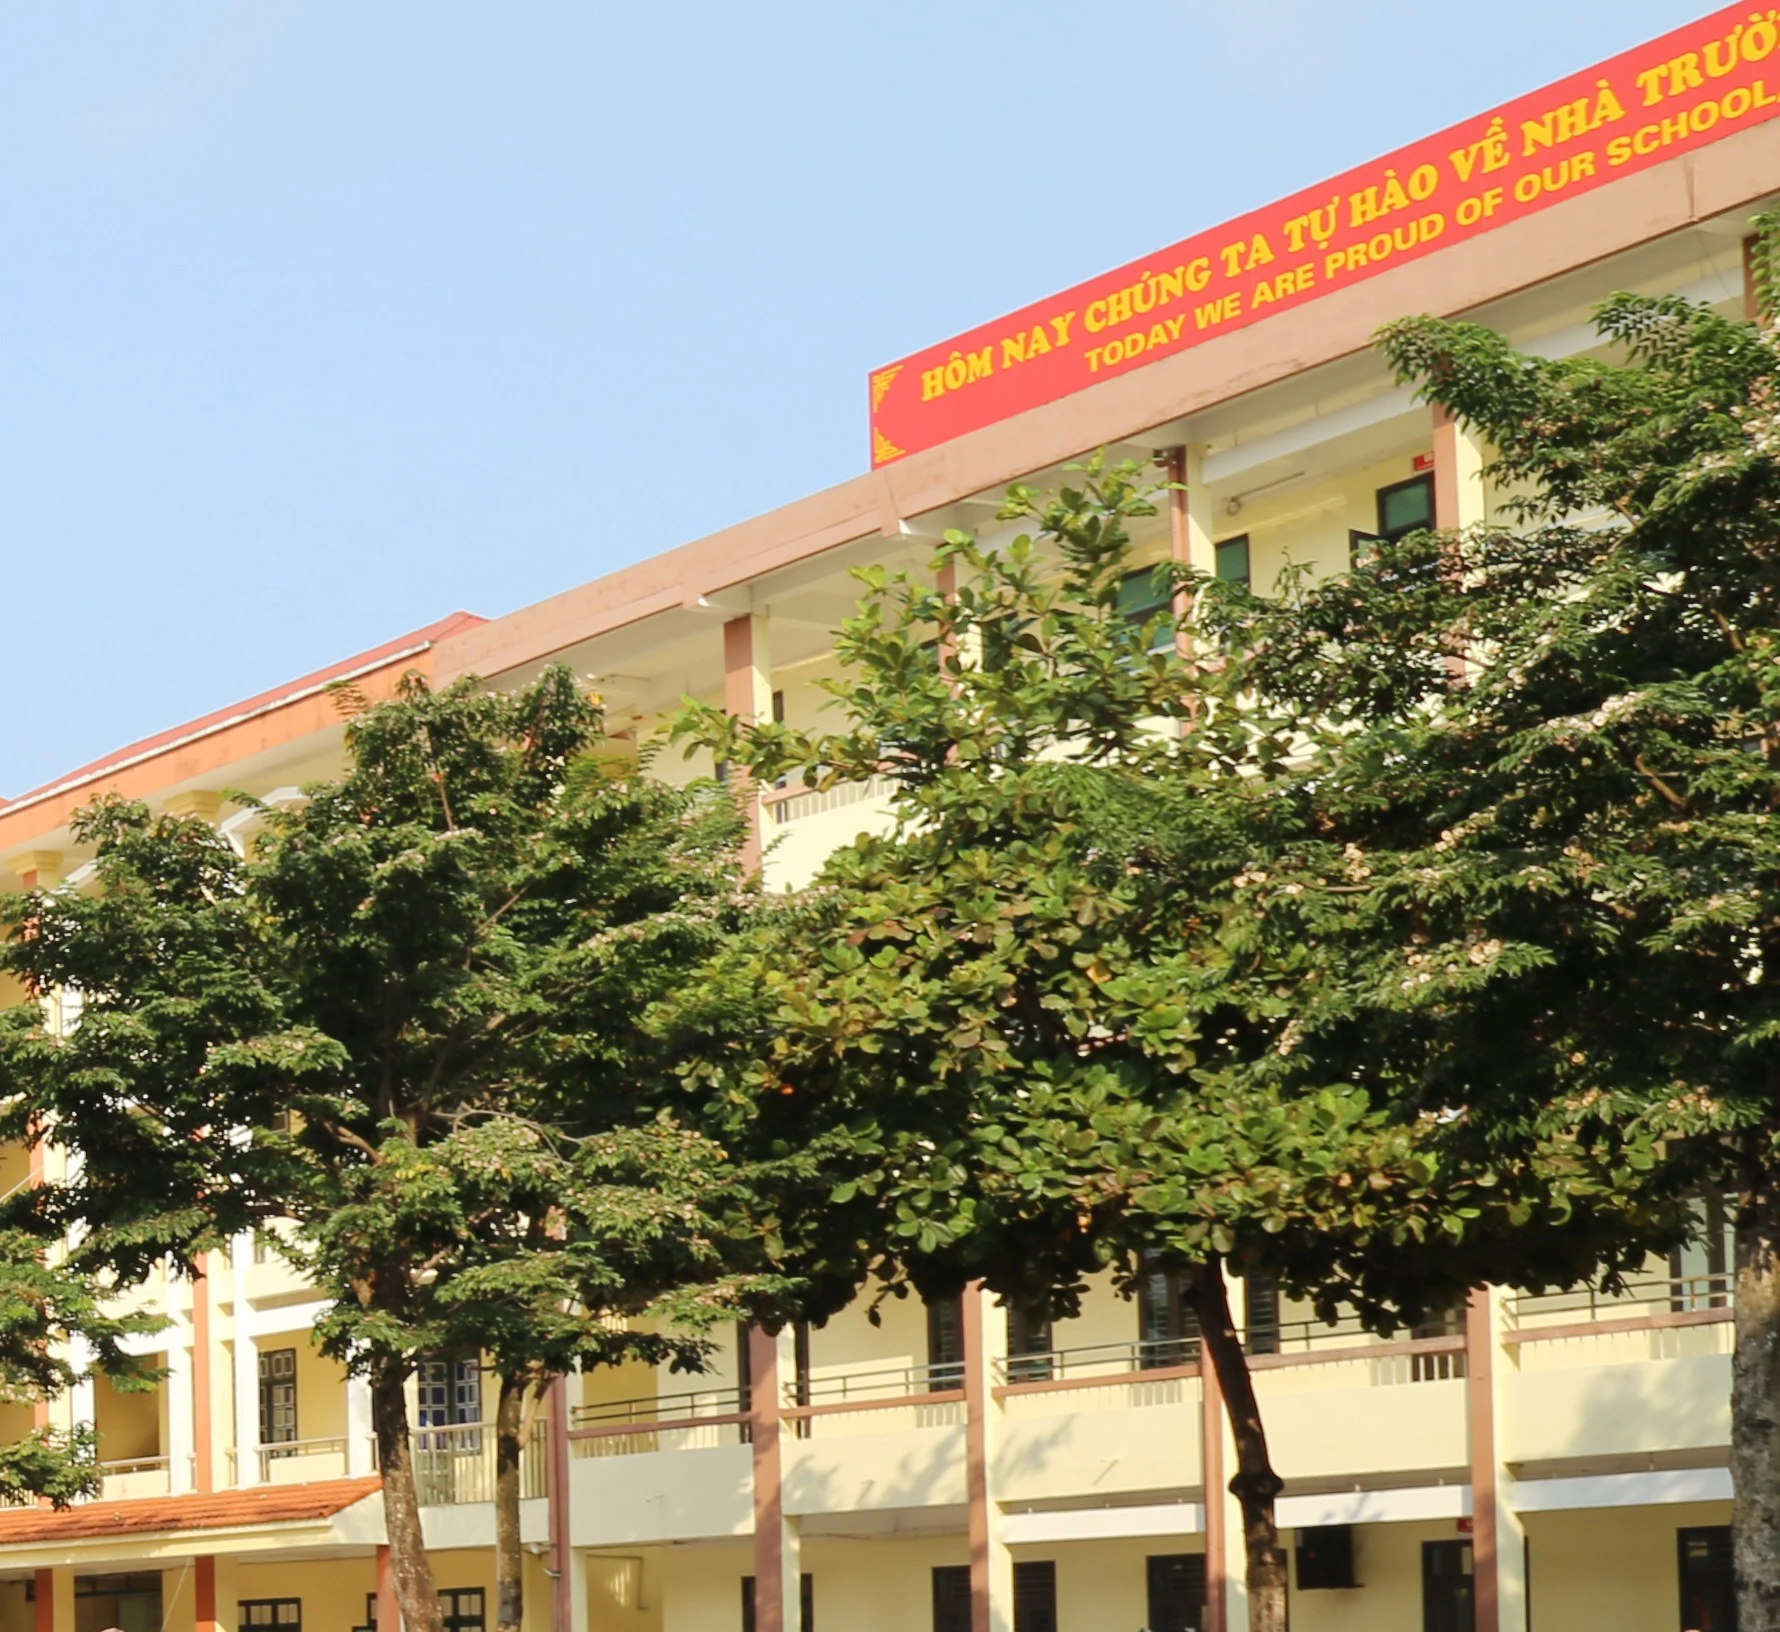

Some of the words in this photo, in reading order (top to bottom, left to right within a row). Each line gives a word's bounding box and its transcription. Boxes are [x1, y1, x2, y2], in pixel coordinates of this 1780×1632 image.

[921, 346, 994, 402] HÔM
[1001, 311, 1076, 369] NAY
[1084, 256, 1212, 333] CHÚNG
[1220, 233, 1275, 278] TA
[1283, 195, 1340, 250] TỰ
[1348, 163, 1439, 228] HÀO
[1448, 116, 1510, 182] VỀ
[1520, 79, 1626, 157] NHÀ
[1636, 9, 1780, 107] TRƯỜ
[1084, 313, 1187, 373] TODAY
[1195, 290, 1242, 330] WE
[1251, 262, 1316, 309] ARE
[1325, 213, 1445, 279] PROUD
[1455, 187, 1504, 227] OF
[1514, 151, 1596, 202] OUR
